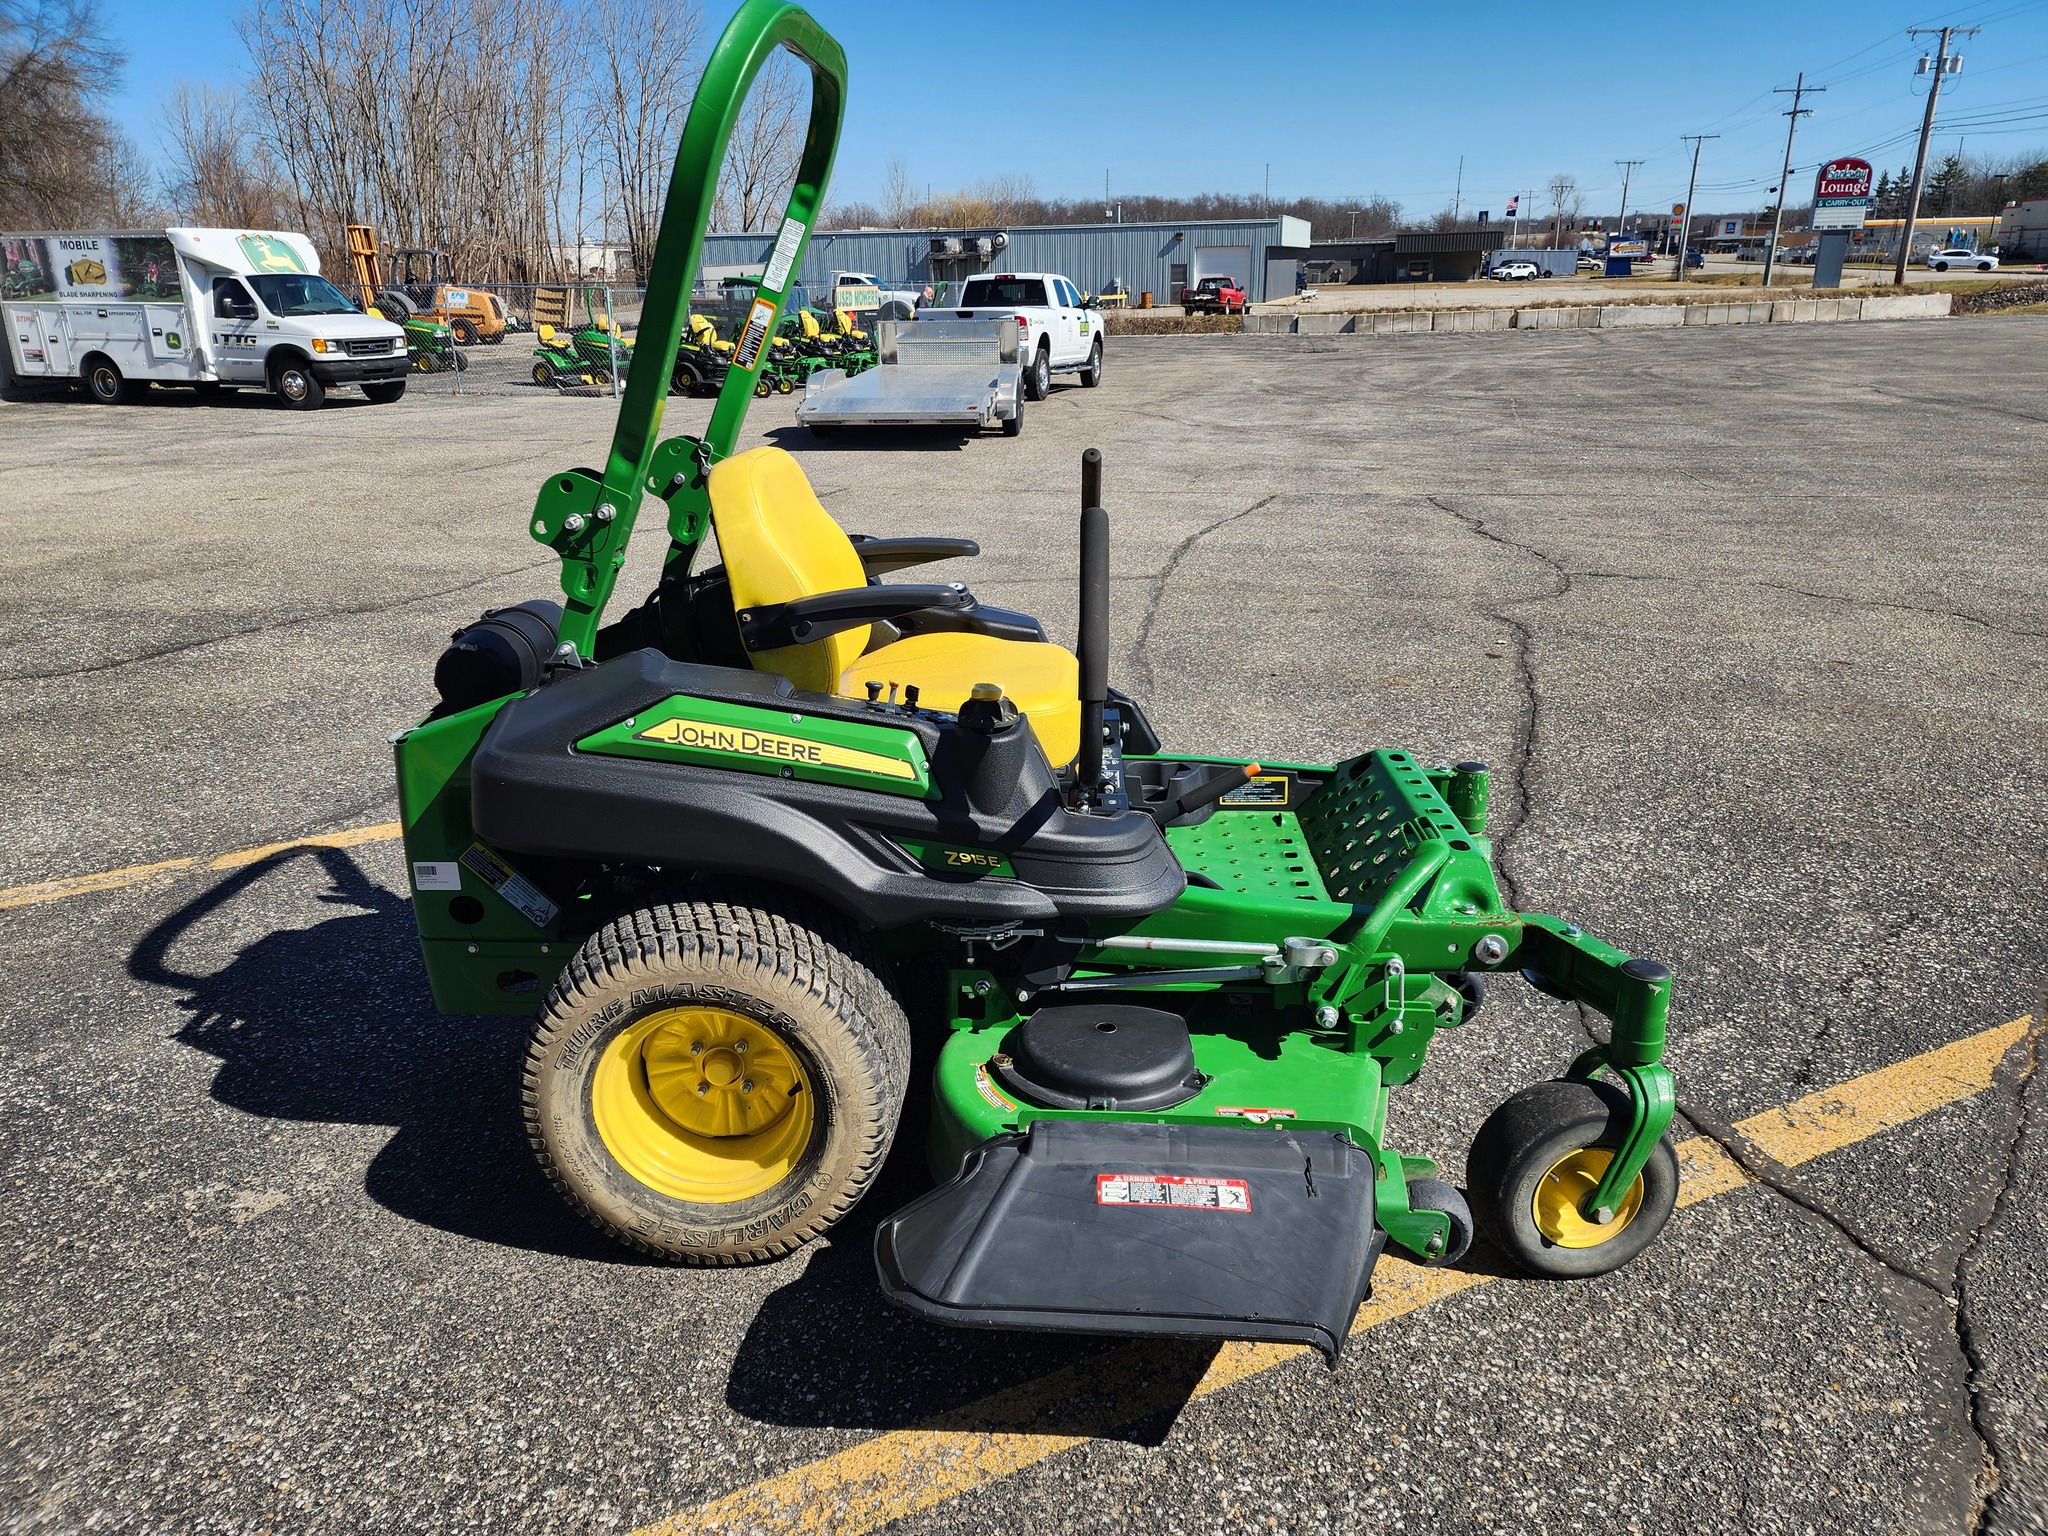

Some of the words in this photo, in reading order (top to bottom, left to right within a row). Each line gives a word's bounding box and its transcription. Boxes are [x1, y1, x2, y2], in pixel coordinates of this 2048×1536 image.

[1826, 164, 1869, 184] Backway
[1820, 181, 1869, 195] Lounge
[59, 240, 99, 250] MOBILE
[837, 290, 853, 307] USED
[854, 290, 878, 306] MOWERS
[221, 334, 257, 346] TTG
[668, 723, 734, 749] JOHN
[742, 732, 822, 762] DEERE
[944, 851, 1001, 868] Z915E
[555, 998, 623, 1071] TURF
[630, 983, 799, 1032] MASTER
[1193, 1178, 1227, 1186] PELIGRO
[628, 1191, 815, 1248] CARLISLE
